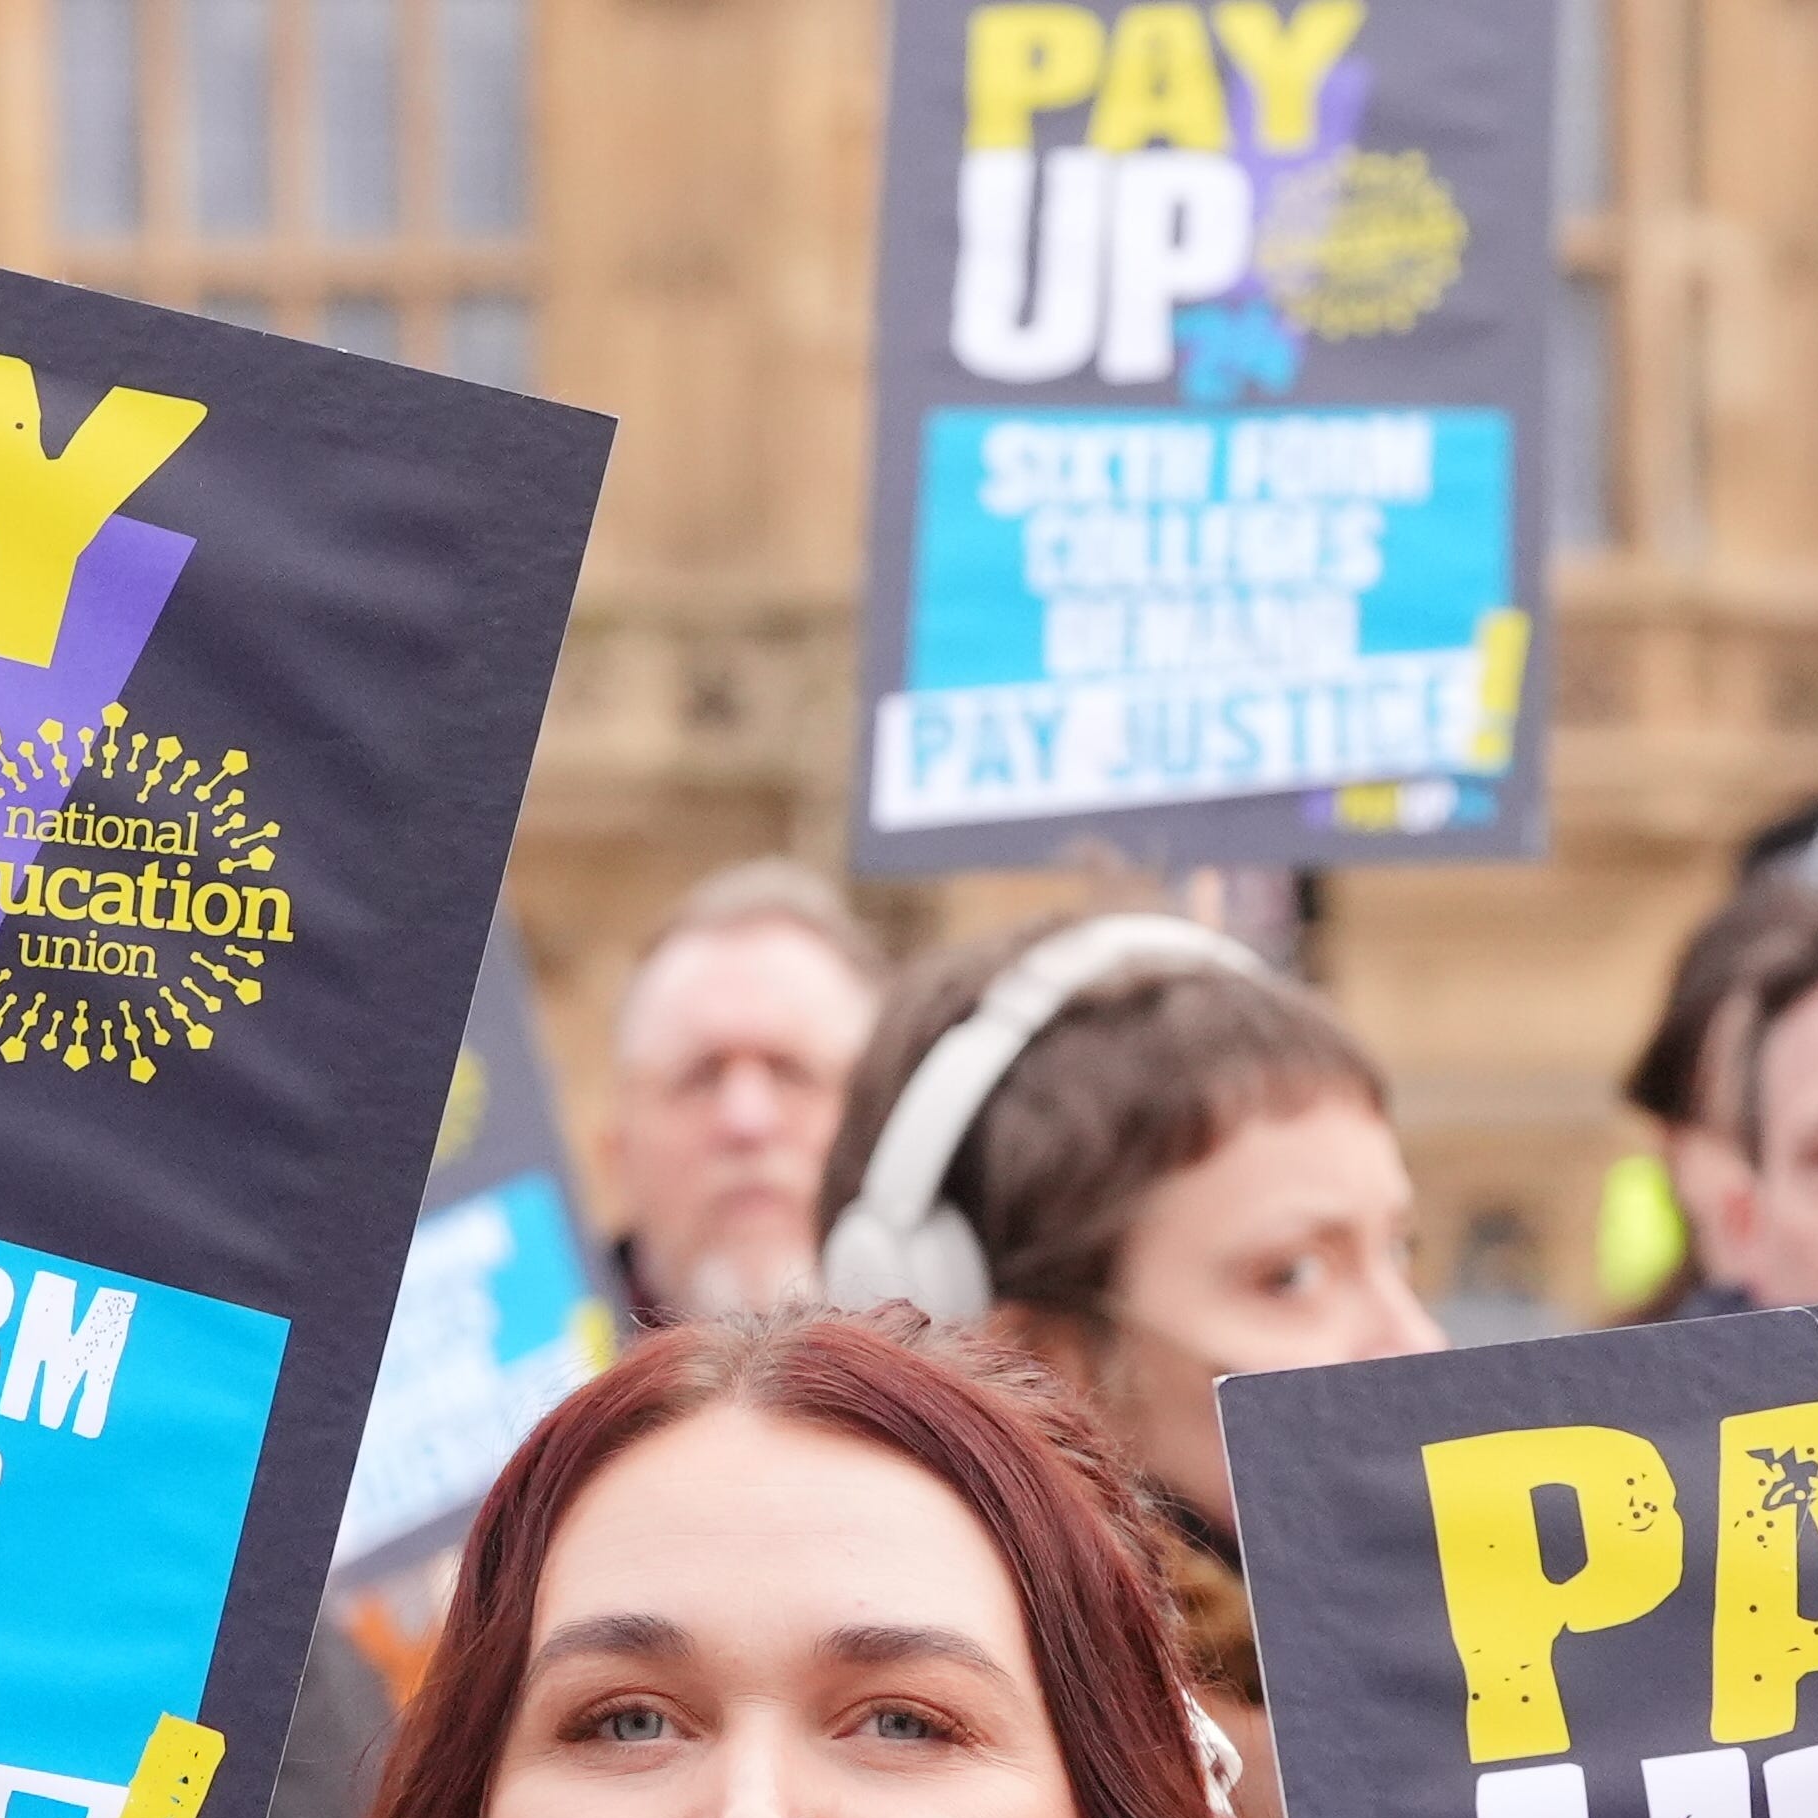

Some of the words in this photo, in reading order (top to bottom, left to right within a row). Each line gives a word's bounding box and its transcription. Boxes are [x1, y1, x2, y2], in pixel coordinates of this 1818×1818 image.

[965, 2, 1366, 152] PAY
[951, 148, 1255, 385] UP
[909, 707, 1069, 791] PAY
[3, 801, 199, 857] national
[17, 928, 159, 980] union
